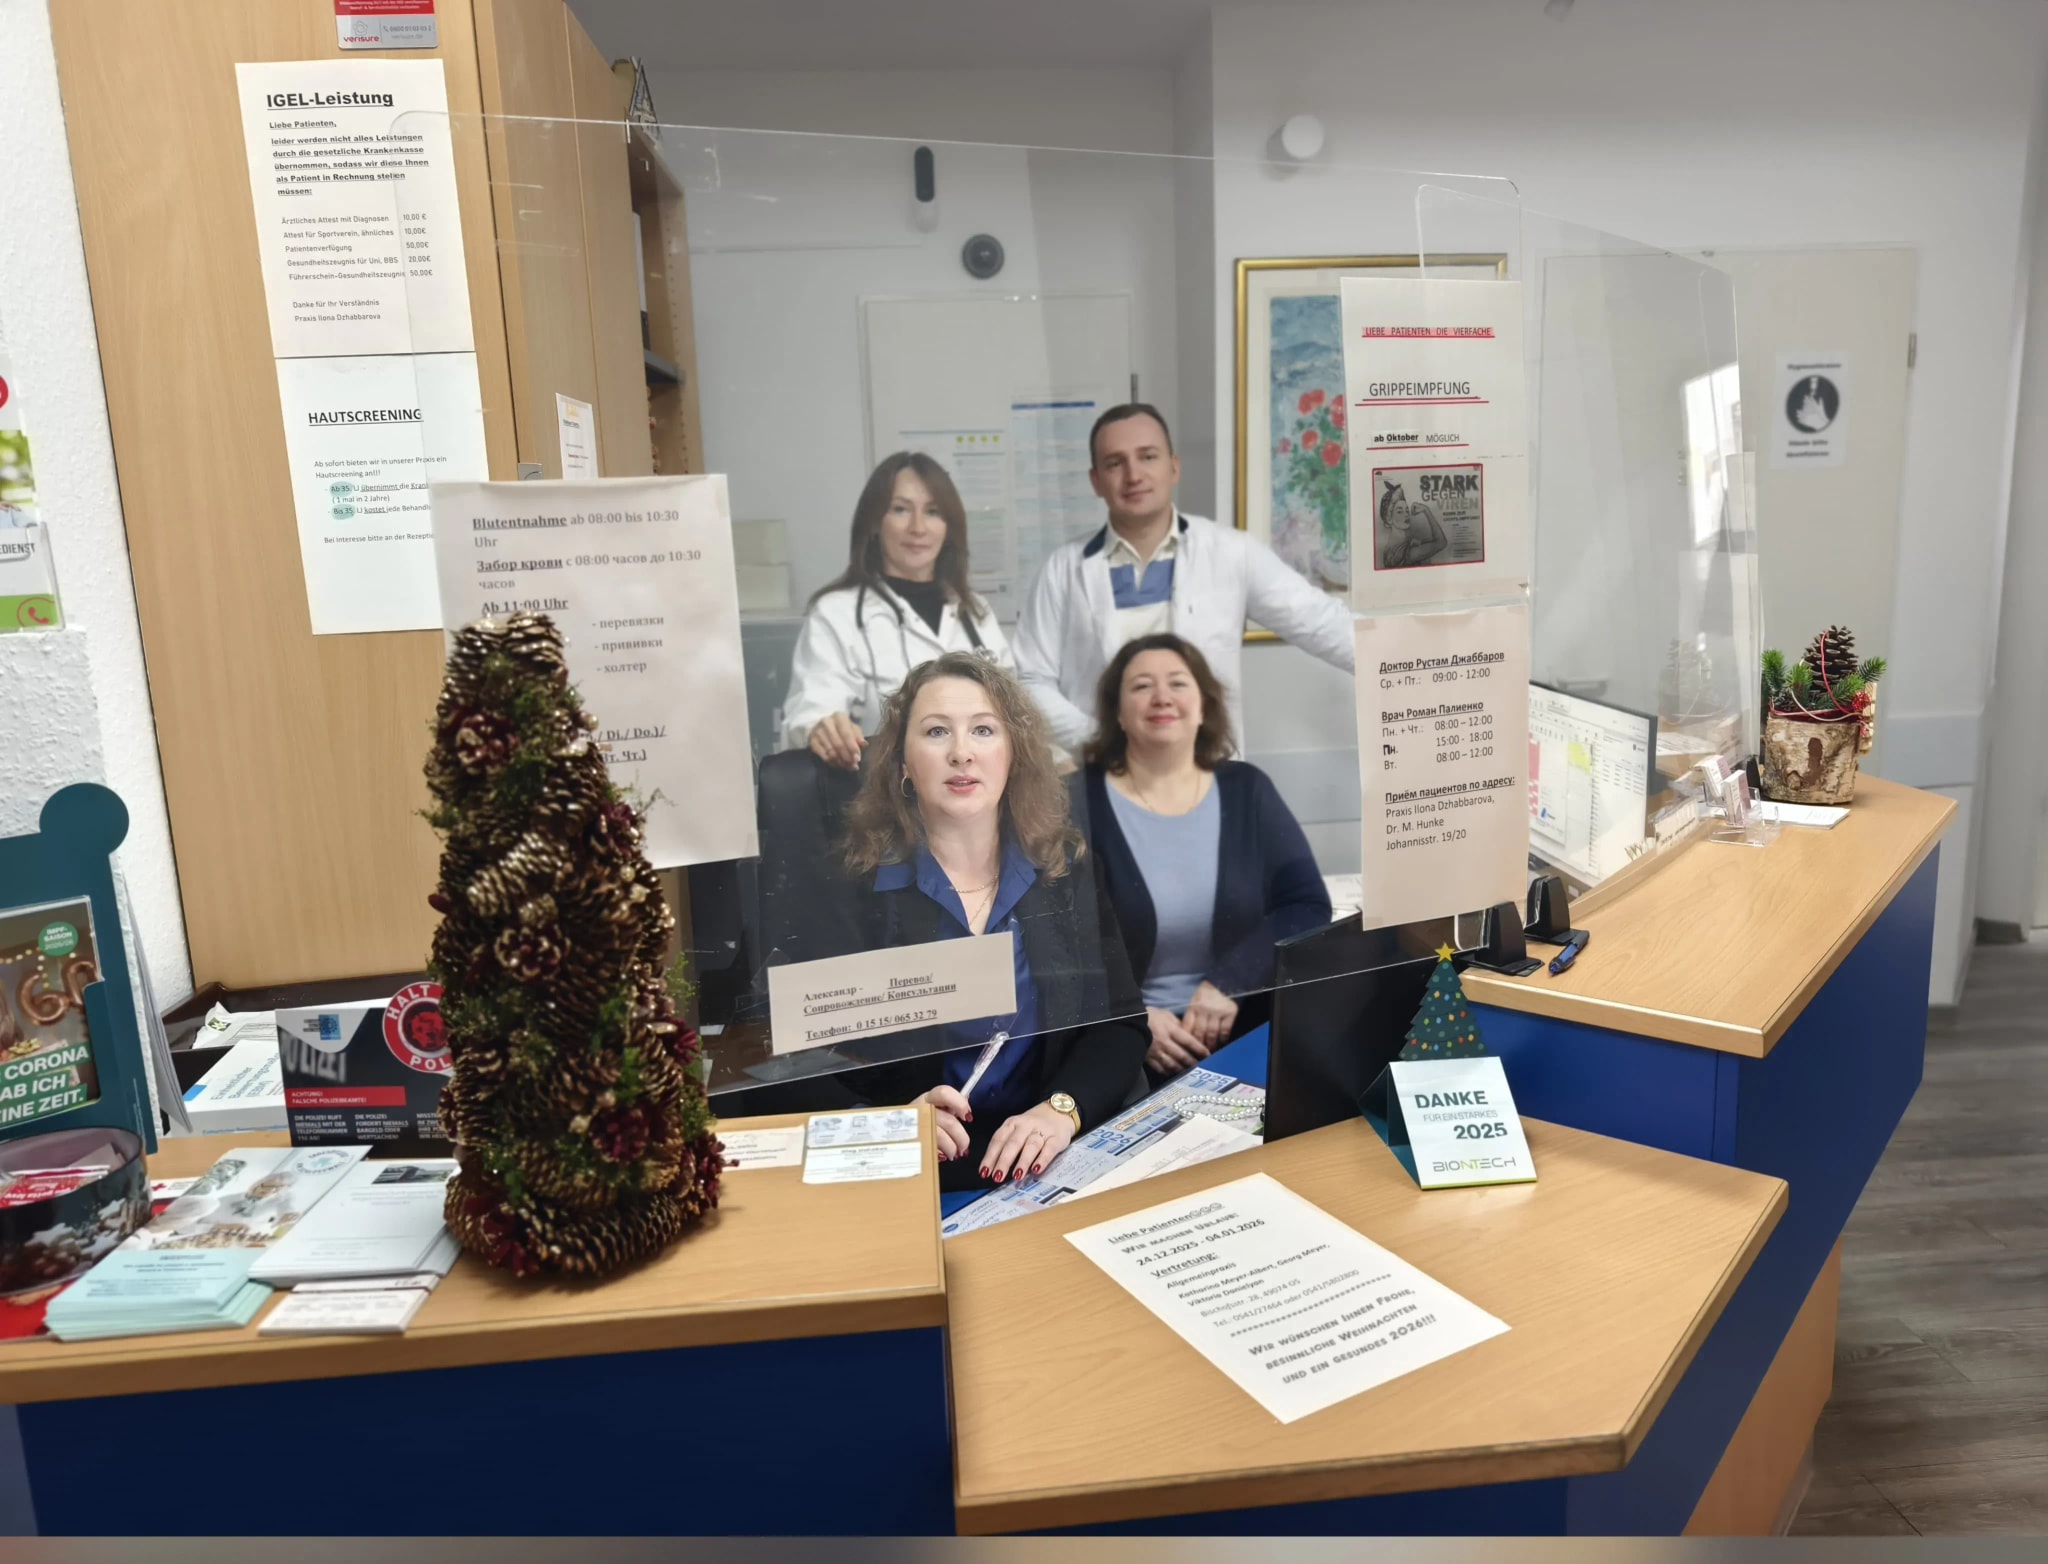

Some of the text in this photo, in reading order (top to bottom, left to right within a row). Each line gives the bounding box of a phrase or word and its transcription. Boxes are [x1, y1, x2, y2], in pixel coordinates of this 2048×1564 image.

[267, 92, 394, 109] IGEL-Leistung
[269, 119, 337, 130] Liebe Patienten,
[271, 134, 423, 146] leider werden nicht alles Leistungen
[273, 147, 424, 158] durch die gesetzliche Krankenkasse
[274, 160, 331, 170] übernommen,
[333, 160, 362, 168] sodass
[380, 159, 403, 167] diese
[405, 158, 429, 167] Ihnen
[276, 171, 405, 183] als Patient in Rechnung stellen
[277, 187, 312, 195] müssen:
[293, 301, 314, 309] Danke
[315, 300, 326, 308] für
[339, 299, 380, 308] Verständnis
[1365, 327, 1491, 335] LIEBE PATIENTEN DIE VIERFACHE
[1369, 382, 1470, 396] GRIPPEIMPFUNG
[308, 408, 422, 424] HAUTSCREENING
[1374, 432, 1460, 443] ab Oktober MÖGLICH
[315, 470, 363, 479] Hautscreening
[1420, 475, 1479, 491] STARK
[1422, 489, 1465, 501] GEGEN
[1438, 498, 1479, 510] VIREN
[473, 510, 679, 530] Blutentnahme ab 08:00 bis 10:30
[0, 543, 35, 554] DIENST
[474, 536, 498, 548] Uhr
[477, 550, 701, 573] Забор крови с 08:00 часов до 10:30
[478, 579, 515, 590] часов
[481, 601, 500, 614] Ab
[543, 598, 568, 610] Uhr
[600, 616, 664, 629] перевязки
[602, 639, 663, 652] прививки
[604, 662, 647, 674] холтер
[1380, 651, 1504, 675] Доктор Рустам Джаббаров
[1380, 667, 1490, 690] Ср. Пт.: 09:00 12:00
[1382, 702, 1484, 723] Врач Роман Палиенко
[1383, 727, 1397, 737] Пн.
[1435, 719, 1459, 731] 08:00
[1383, 731, 1493, 755] Пн. 15:00 18:00
[1384, 746, 1493, 770] Вт. 08:00 12:00
[1385, 775, 1515, 803] Приём пациентов по адресу:
[1386, 793, 1495, 818] Praxis Ilona Dzhabbarova,
[1387, 817, 1444, 834] Dr. M. Hunke
[1387, 829, 1466, 851] Johannisstr. 19/20
[803, 985, 857, 1001] Александр
[804, 983, 957, 1015] Сопровождение/ Консультации
[387, 984, 430, 1021] HALT
[805, 1009, 937, 1041] Телефон: 0 15 15/ 065 32 79
[4, 1046, 89, 1080] CORONA
[32, 1074, 66, 1094] ICH
[1189, 1070, 1229, 1086] 2025
[0, 1088, 84, 1123] INE ZEIT.
[1414, 1090, 1488, 1108] DANKE
[1457, 1110, 1498, 1120] STARKES
[1091, 1129, 1134, 1144] 2026
[1453, 1122, 1508, 1139] 2025
[1432, 1157, 1517, 1172] BIONTECH
[1108, 1230, 1138, 1245] Liebe
[1136, 1219, 1265, 1267] 24.12.2025 04.01.2026
[1151, 1251, 1219, 1279] Vertretung:
[1178, 1242, 1330, 1300] Katharina Meyer-Albert, Georg Meyer,
[1166, 1261, 1237, 1289] Allgemeinpraxis
[1187, 1278, 1265, 1307] Viktoria Danielyan
[1388, 1313, 1438, 1342] 2026!!!
